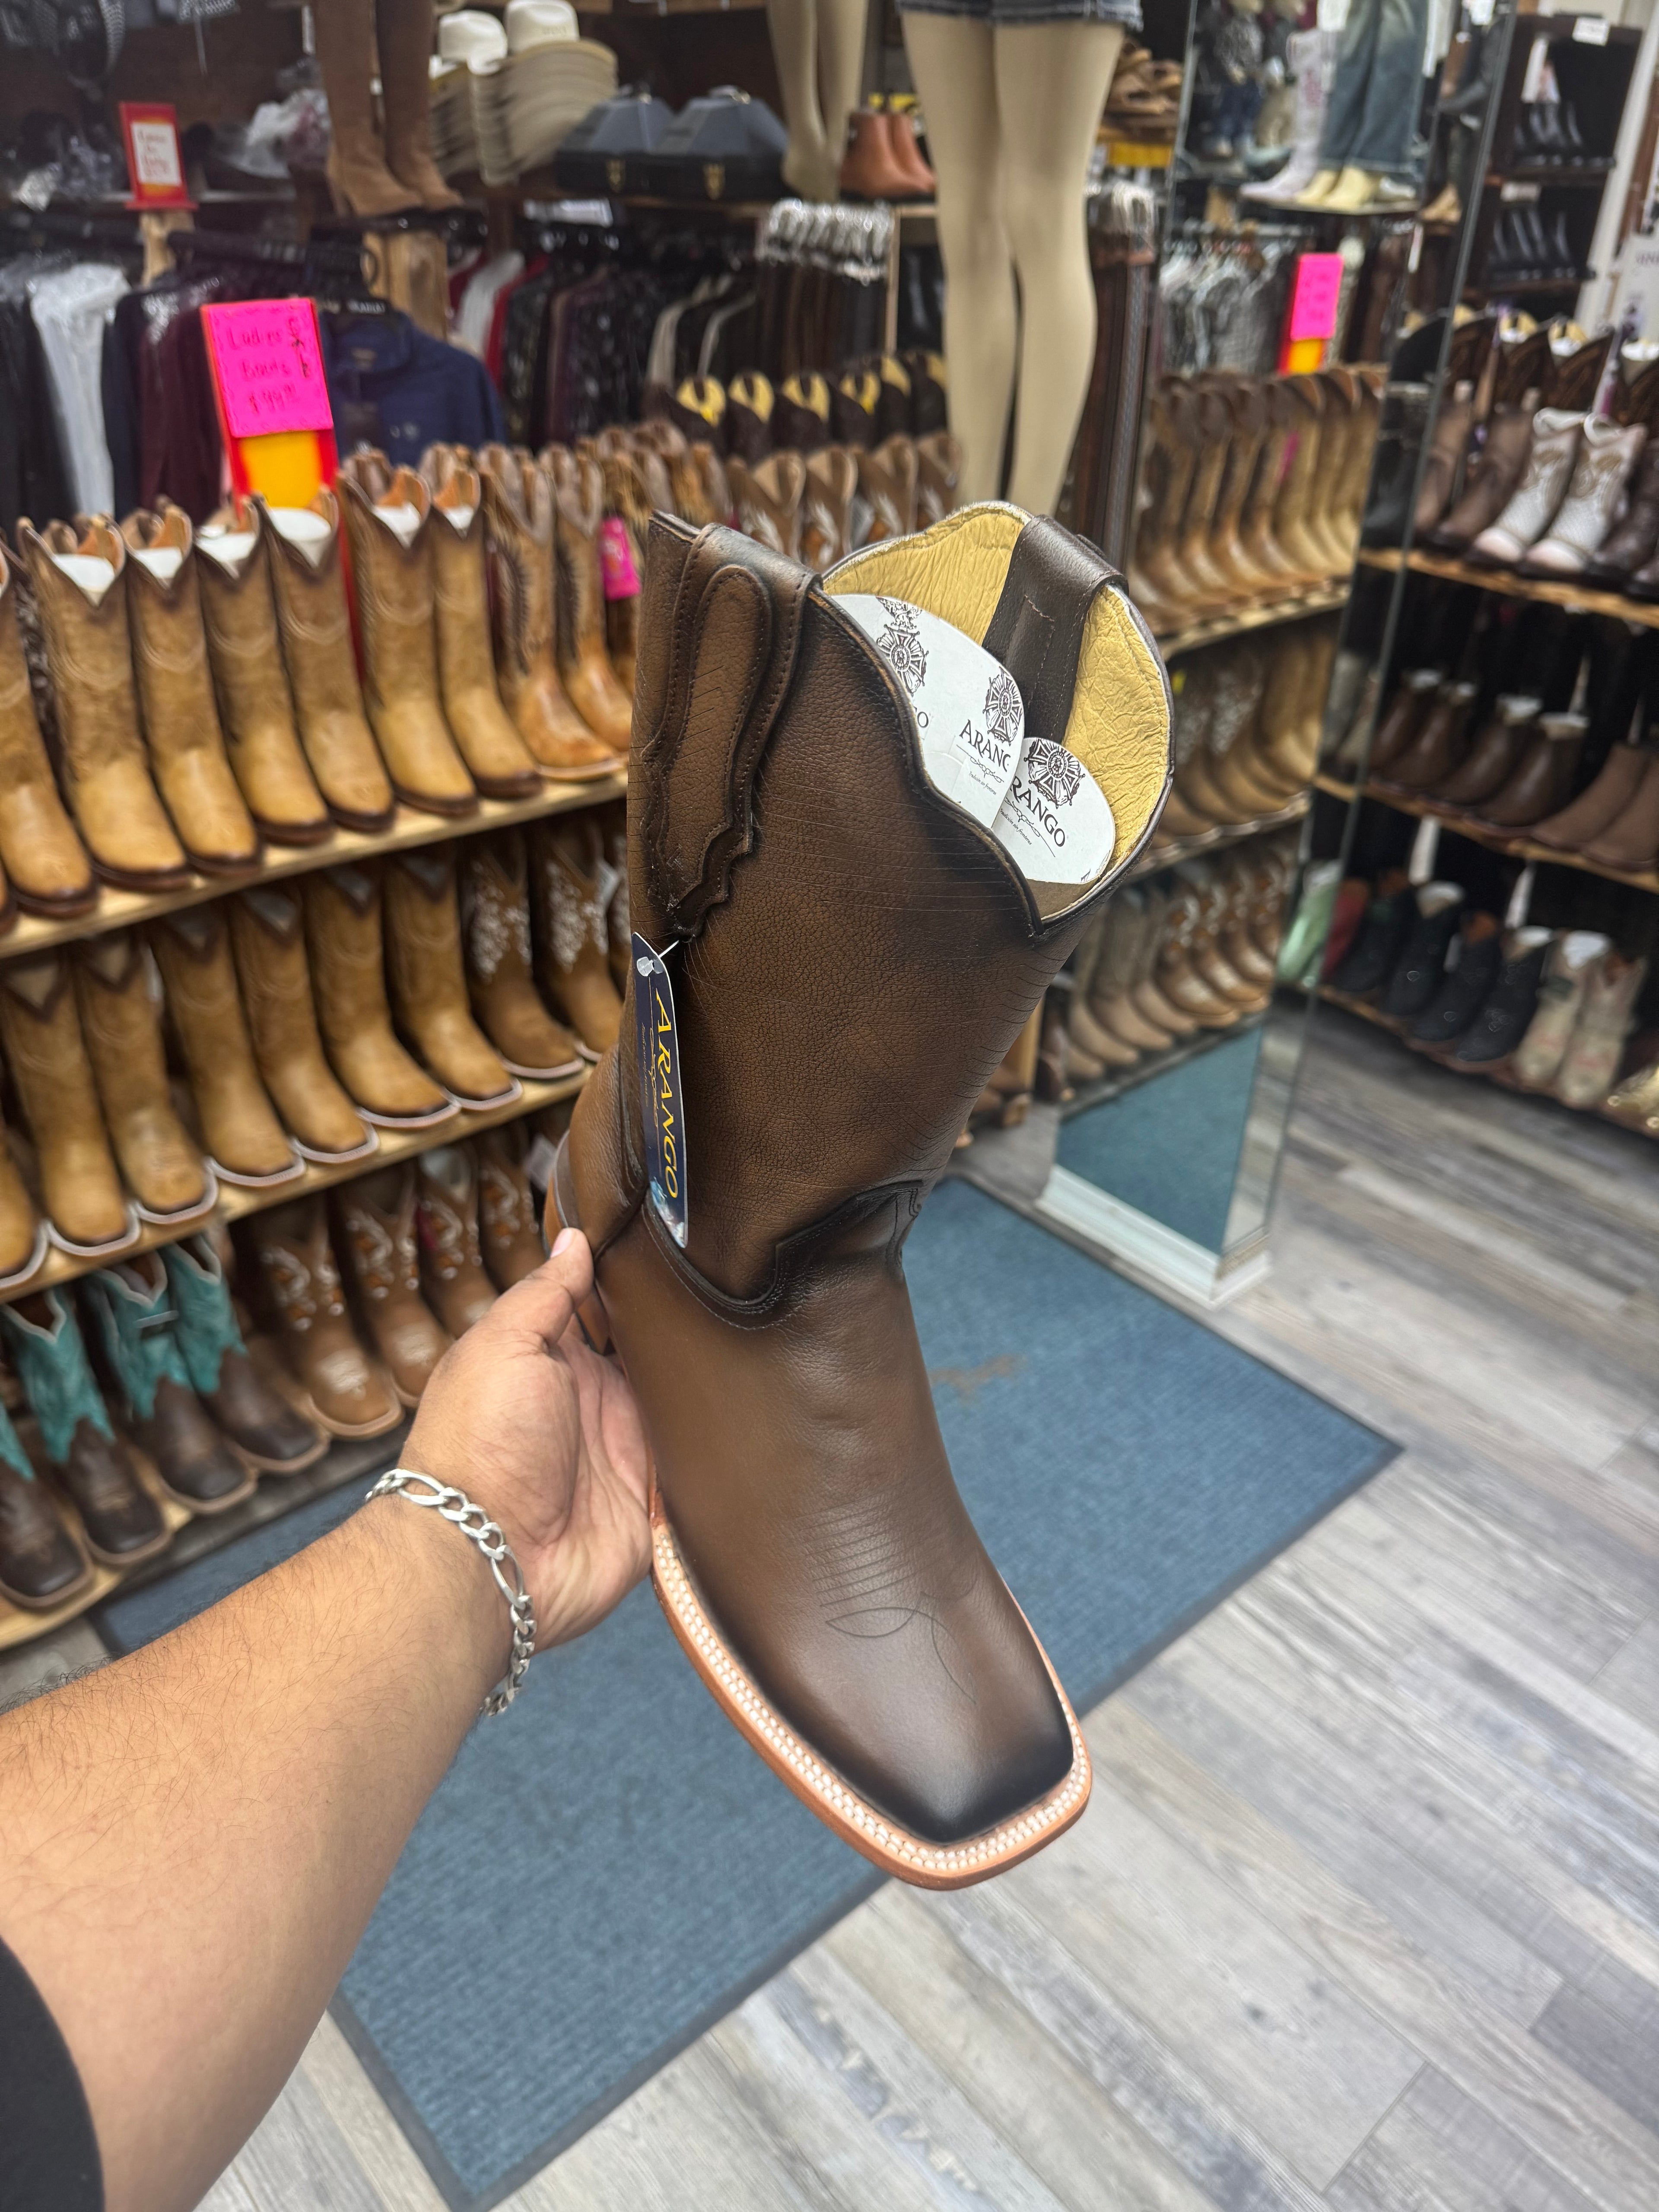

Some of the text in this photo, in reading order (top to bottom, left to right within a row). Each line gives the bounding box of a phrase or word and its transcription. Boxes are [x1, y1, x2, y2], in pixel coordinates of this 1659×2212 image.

[1010, 776, 1065, 847] RANGO
[1016, 828, 1032, 845] fronteras
[655, 988, 678, 1198] ARANGO
